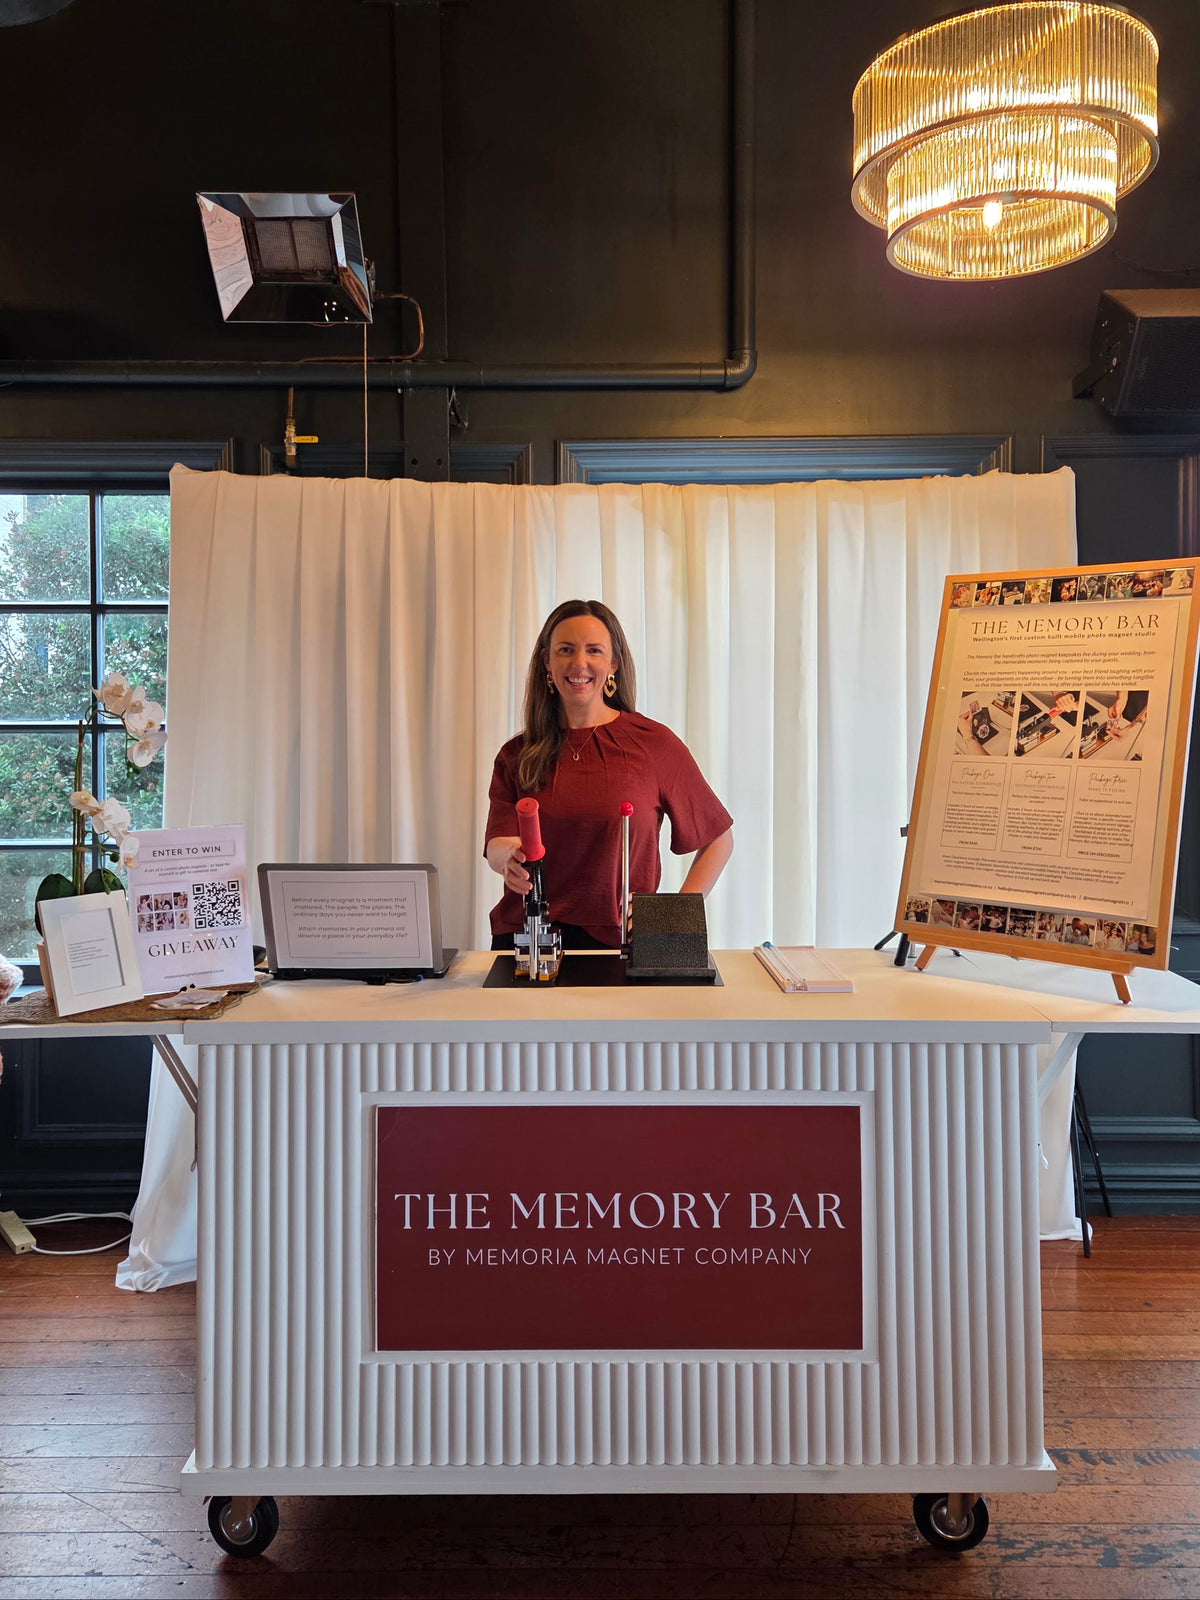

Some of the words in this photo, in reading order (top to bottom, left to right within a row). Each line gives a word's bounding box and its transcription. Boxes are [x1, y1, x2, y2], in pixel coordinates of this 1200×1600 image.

[972, 620, 1009, 635] THE
[1016, 616, 1109, 633] MEMORY
[1117, 614, 1160, 630] BAR
[1087, 631, 1106, 639] photo
[152, 848, 183, 858] ENTER
[185, 847, 199, 855] TO
[201, 845, 222, 854] WIN
[148, 936, 239, 958] GIVEAWAY
[394, 1192, 491, 1230] THE
[510, 1192, 731, 1230] MEMORY
[749, 1192, 846, 1230] BAR
[428, 1248, 456, 1265] BY
[466, 1248, 577, 1265] MEMORIA
[587, 1247, 685, 1265] MAGNET
[695, 1247, 812, 1265] COMPANY
